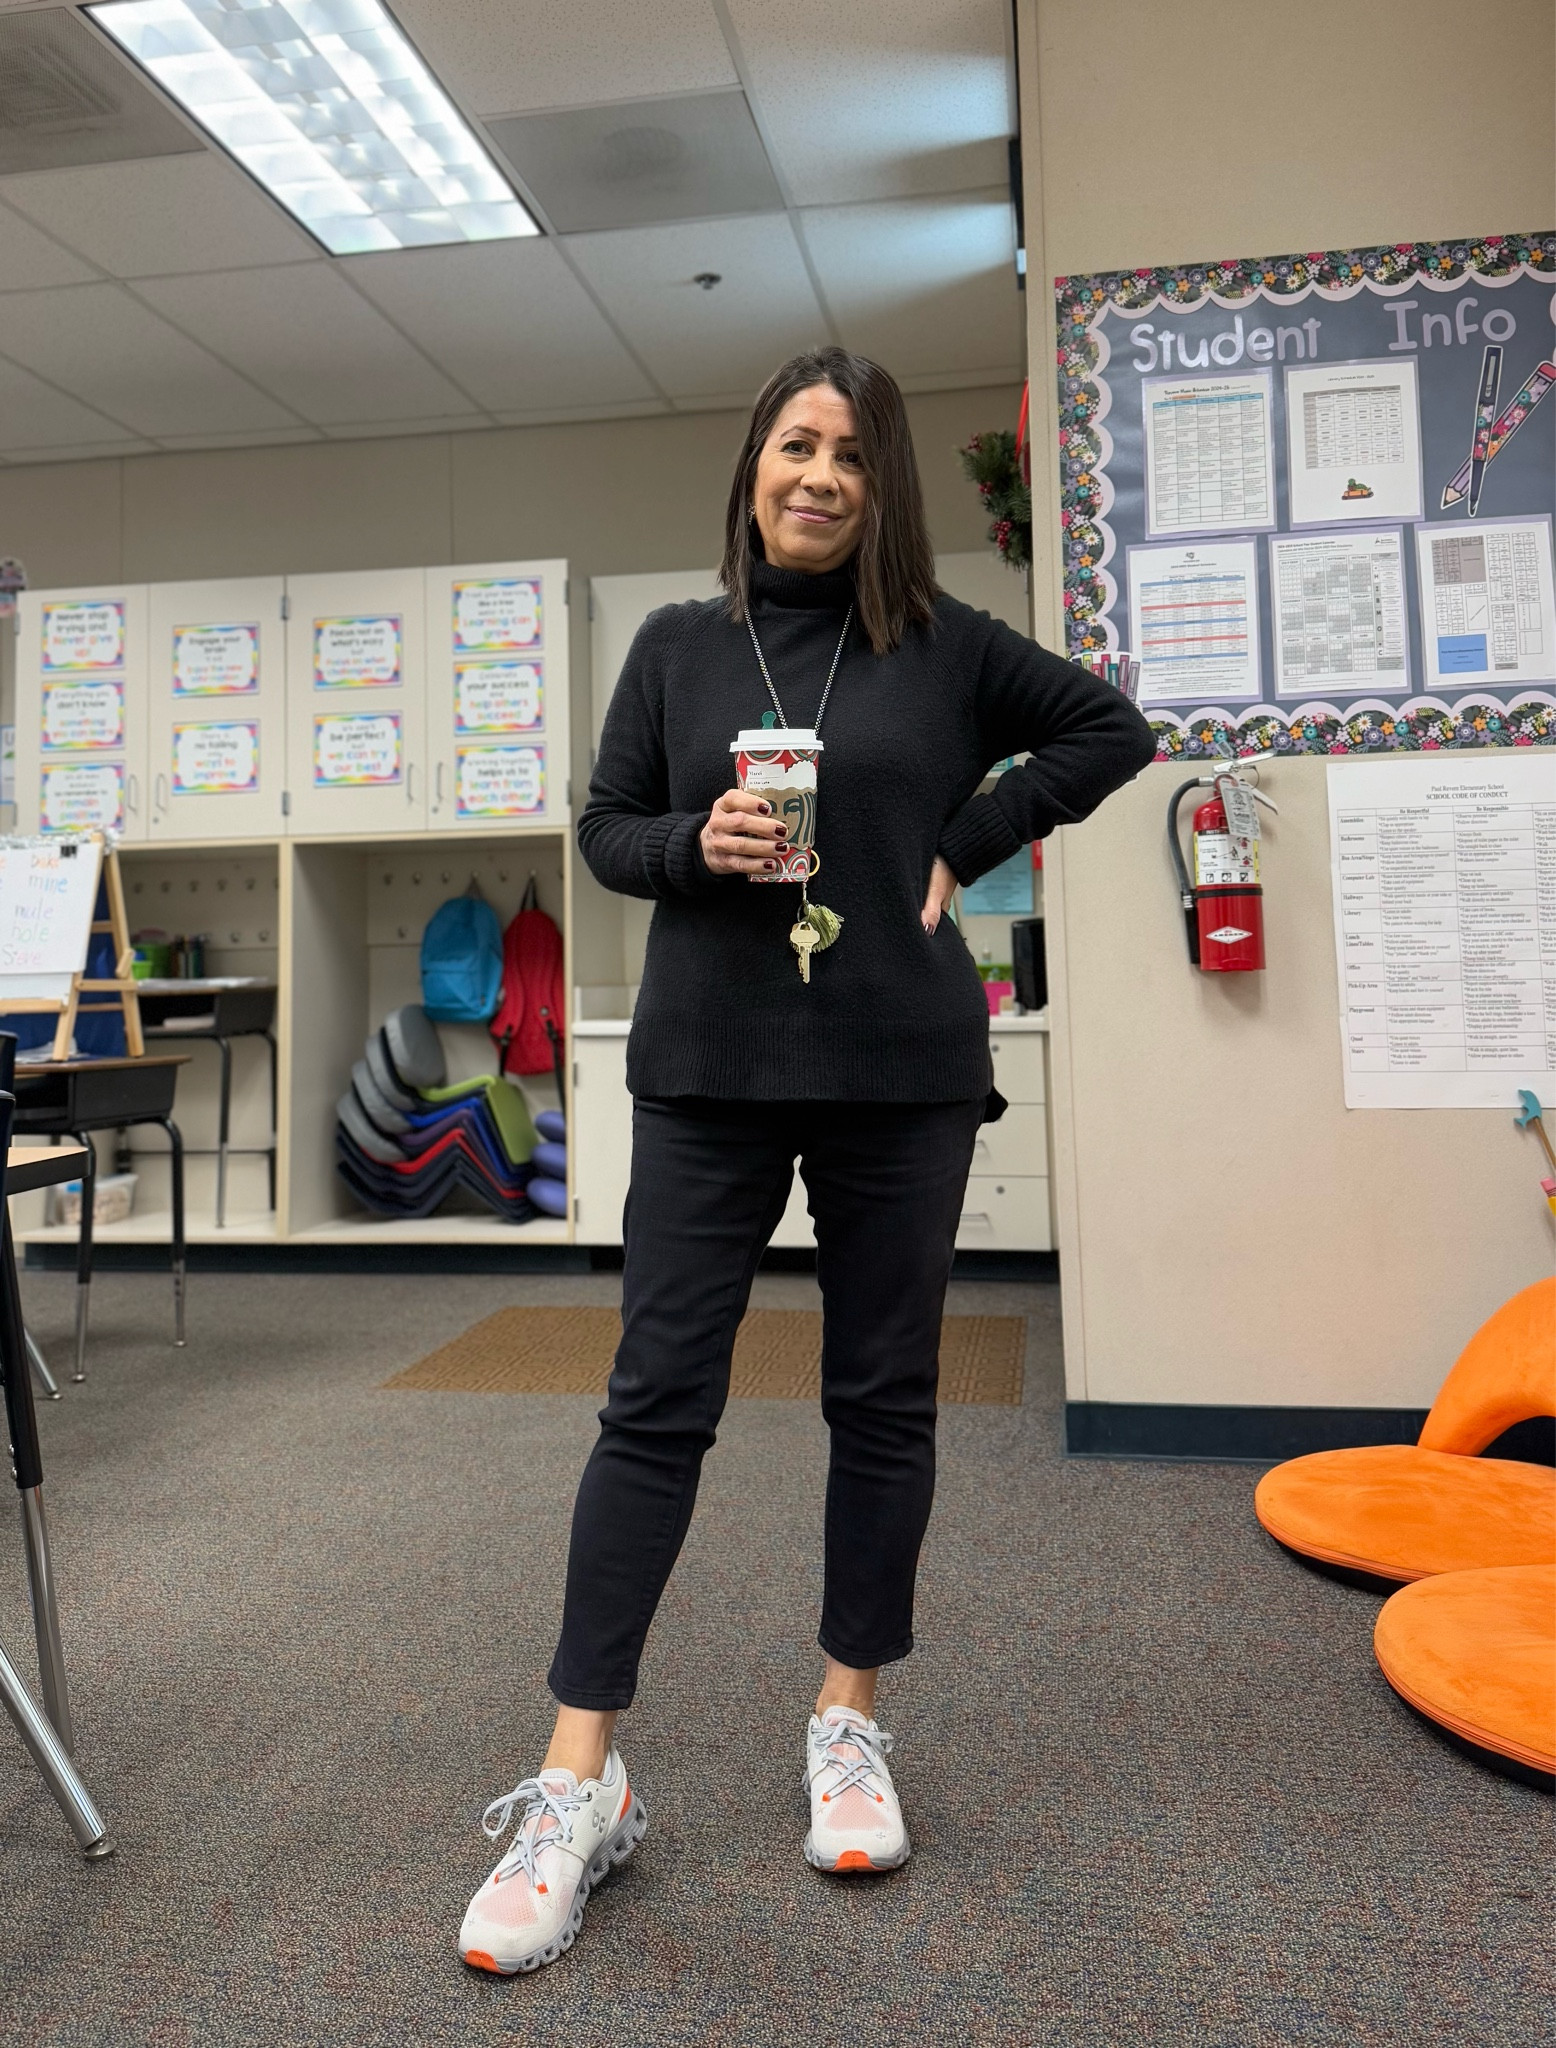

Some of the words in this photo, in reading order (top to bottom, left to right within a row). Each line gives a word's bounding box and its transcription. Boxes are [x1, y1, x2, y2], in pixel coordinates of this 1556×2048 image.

[1130, 313, 1321, 372] Student
[1383, 297, 1517, 351] Info
[1460, 784, 1487, 792] Elementary
